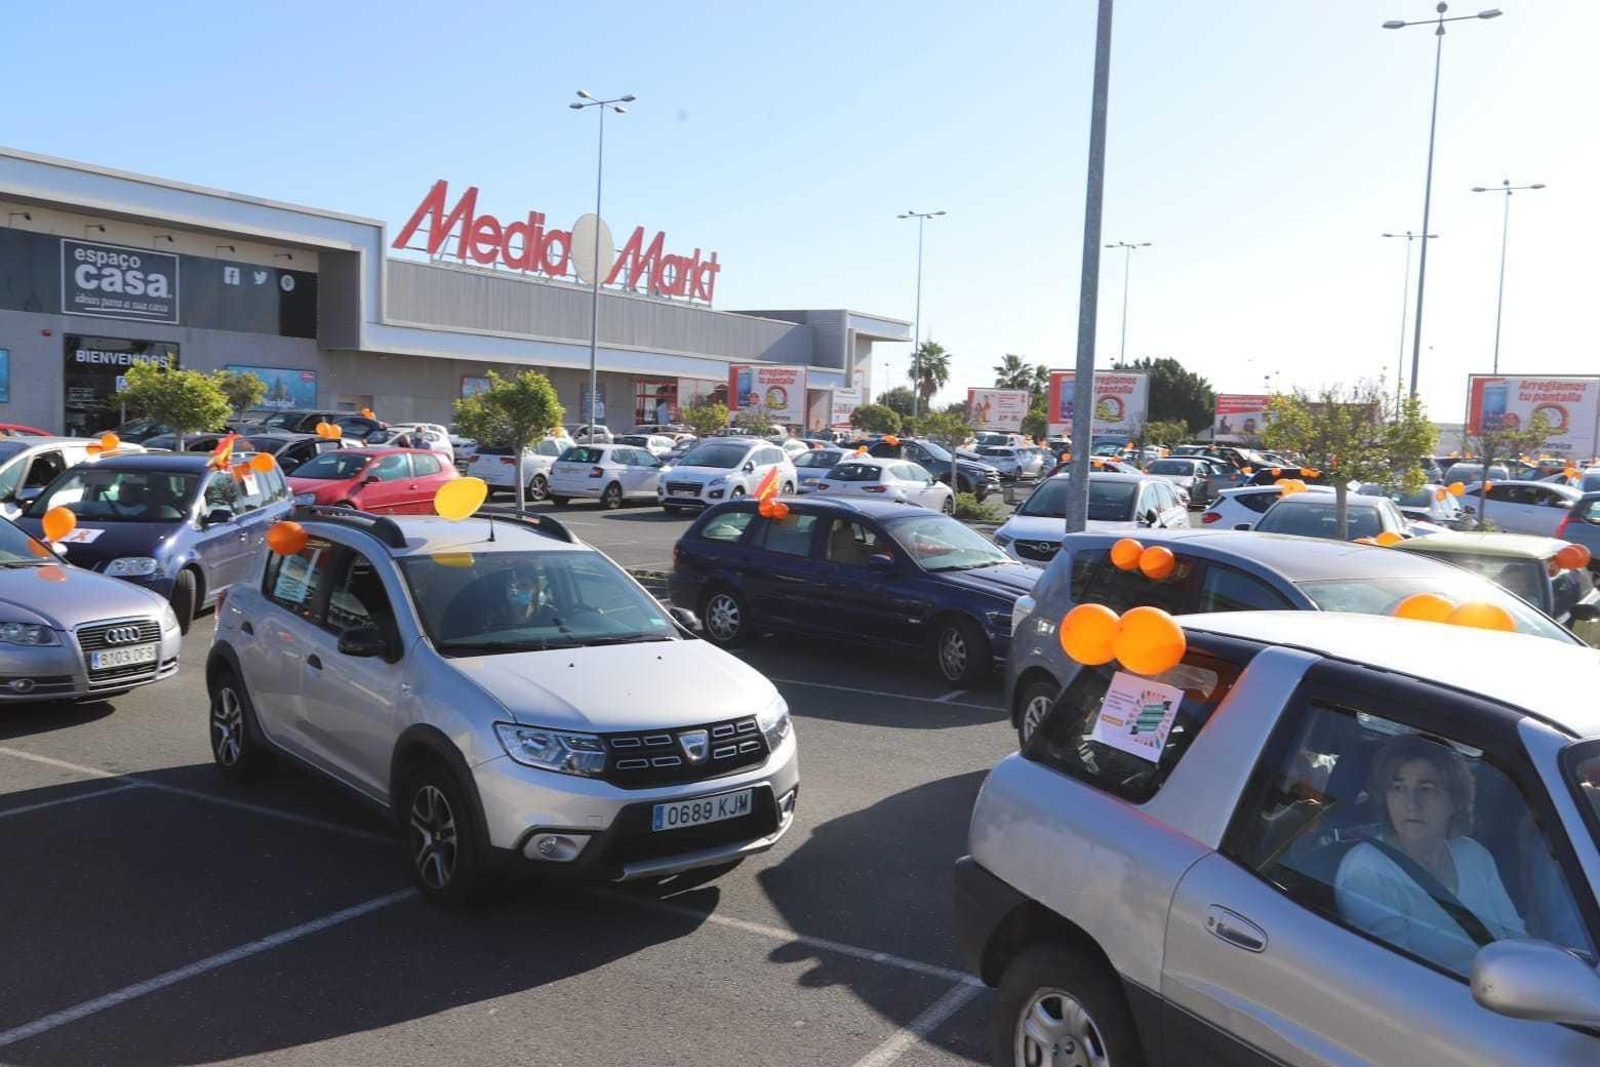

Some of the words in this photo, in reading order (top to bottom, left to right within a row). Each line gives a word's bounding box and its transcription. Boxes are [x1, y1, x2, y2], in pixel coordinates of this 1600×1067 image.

[391, 179, 573, 277] Media
[605, 226, 721, 301] Markt
[74, 248, 141, 270] espaço
[75, 264, 168, 298] casa
[101, 297, 123, 309] para
[148, 304, 169, 313] casa
[668, 802, 713, 825] 0689
[718, 793, 749, 817] KJM
